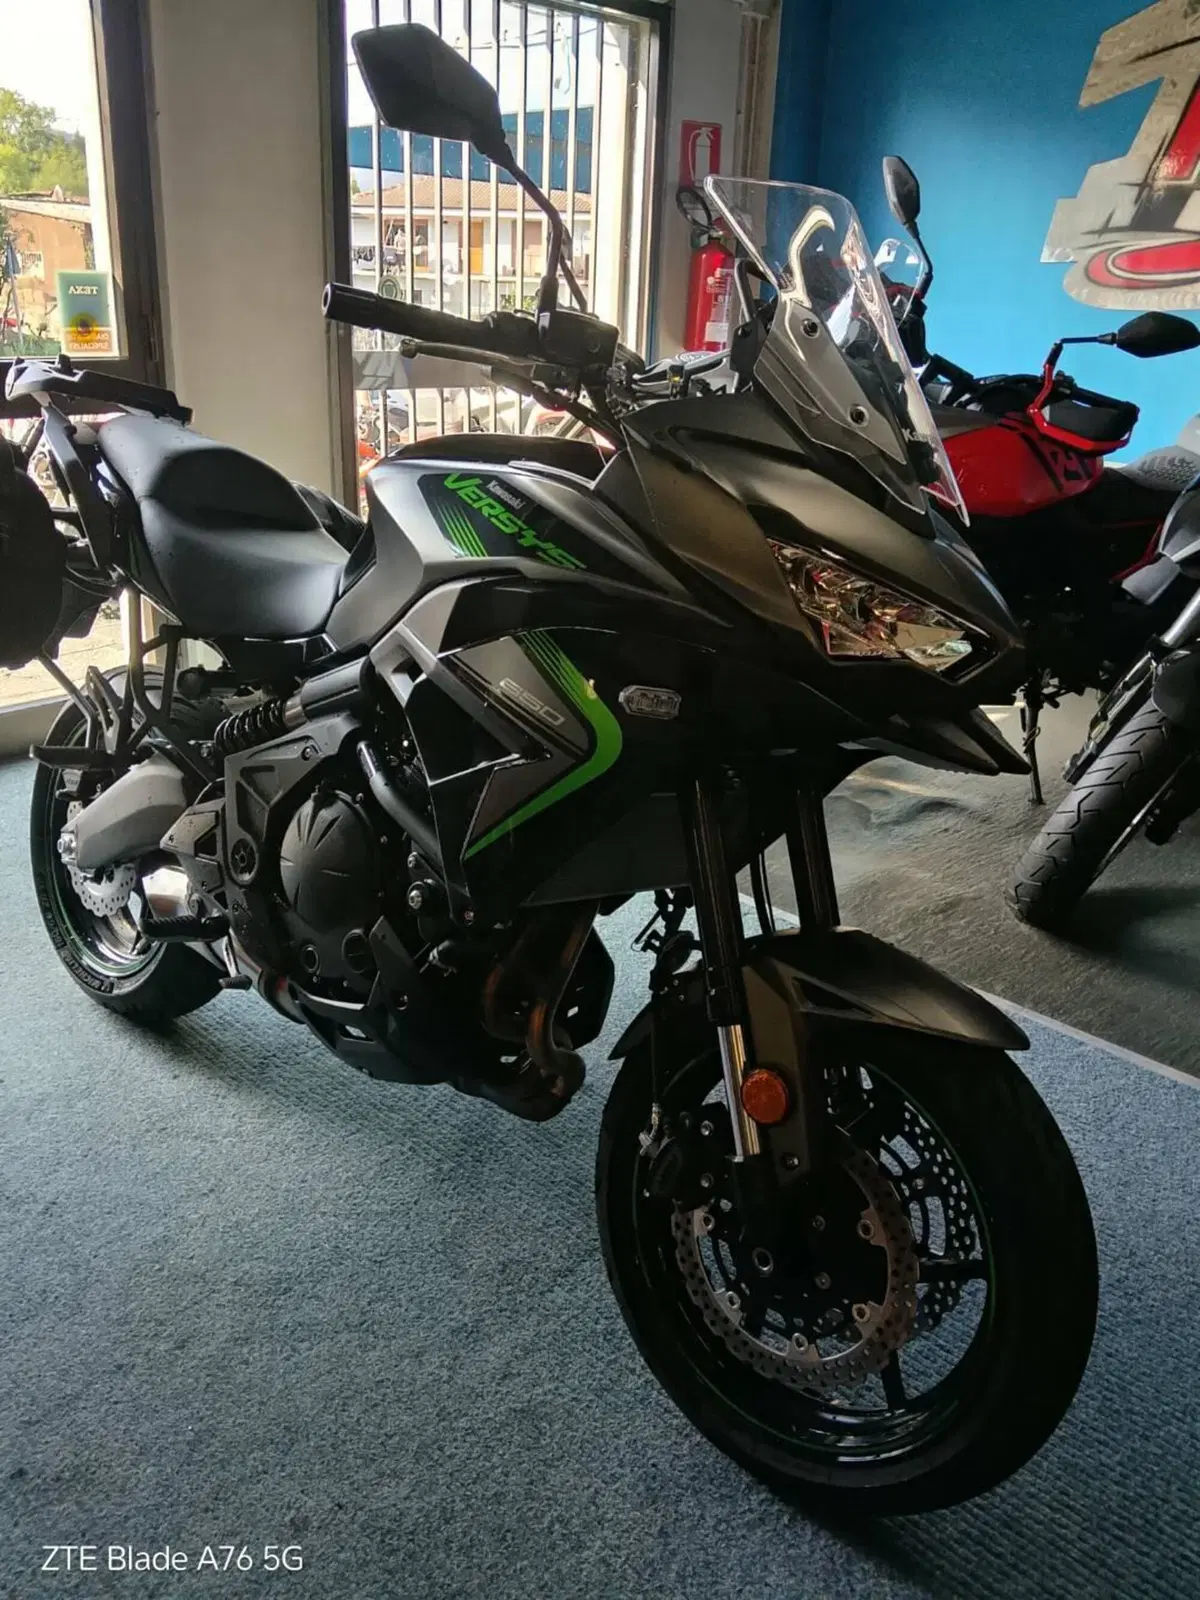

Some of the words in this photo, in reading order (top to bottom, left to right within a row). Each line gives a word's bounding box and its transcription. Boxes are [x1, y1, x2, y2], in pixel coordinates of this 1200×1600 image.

[486, 479, 528, 510] Kawasaki
[443, 472, 587, 569] VERSYS
[500, 677, 565, 726] 650
[65, 954, 102, 988] MICHELIN
